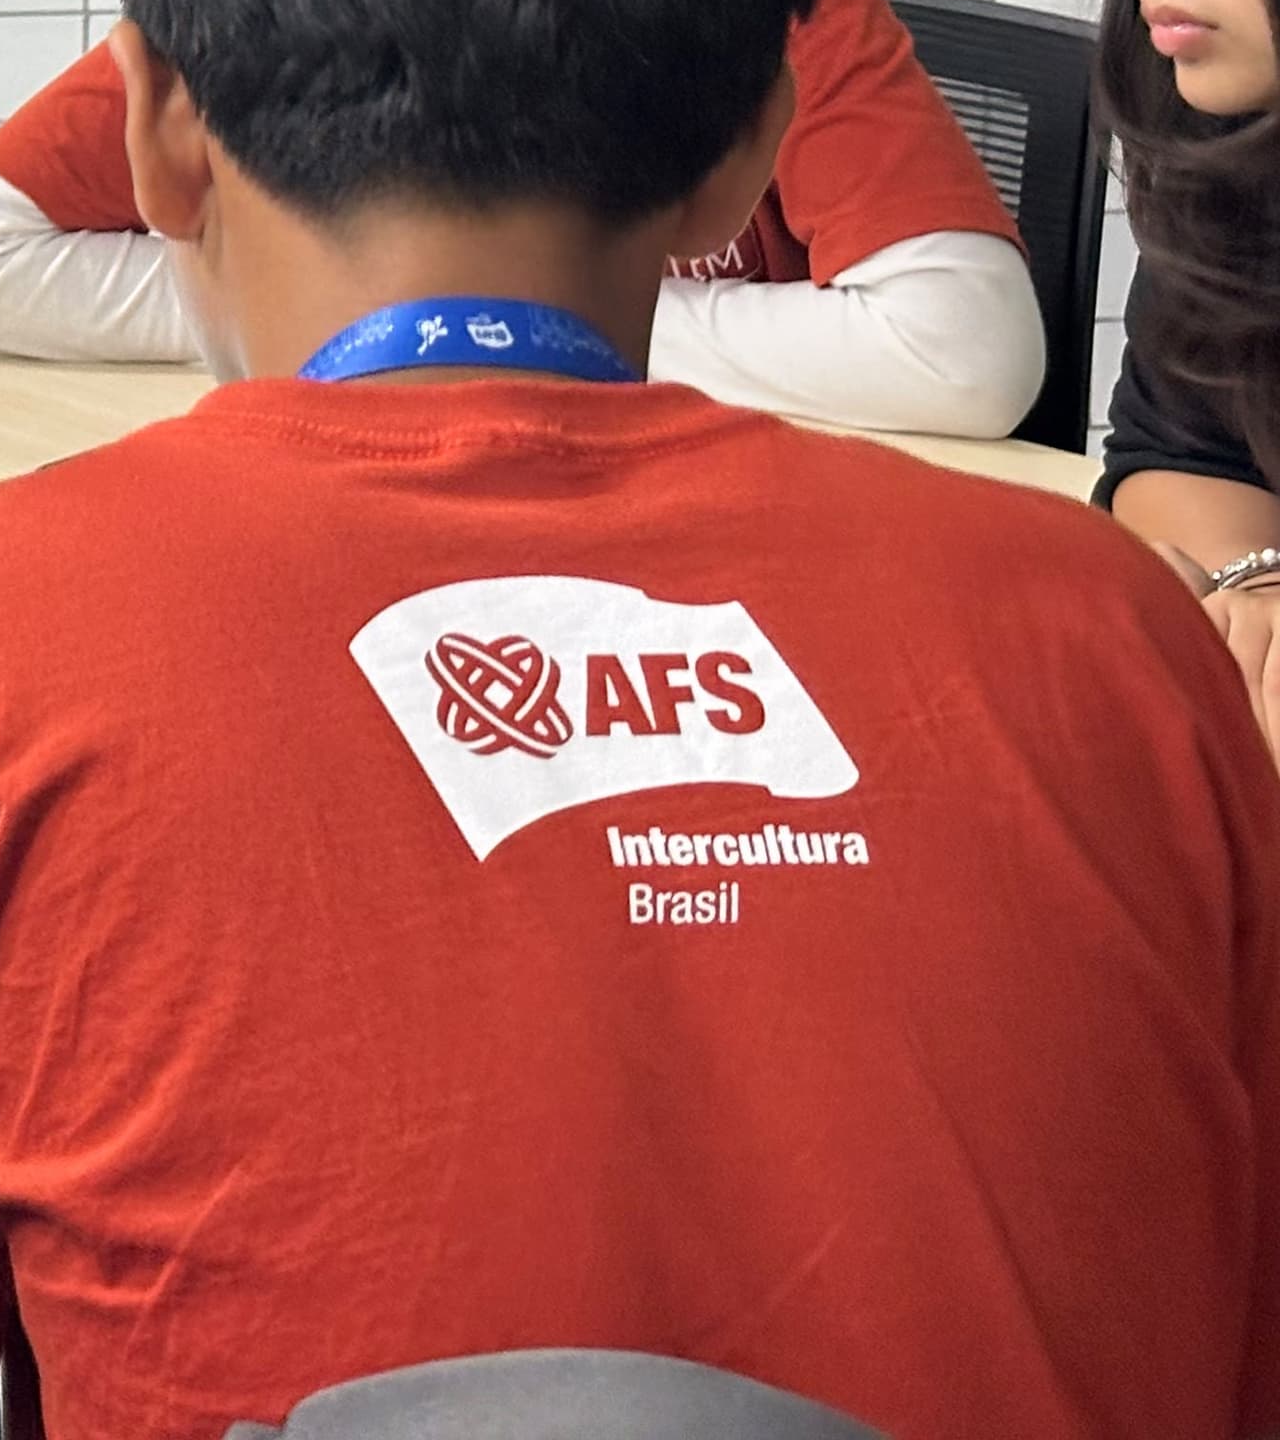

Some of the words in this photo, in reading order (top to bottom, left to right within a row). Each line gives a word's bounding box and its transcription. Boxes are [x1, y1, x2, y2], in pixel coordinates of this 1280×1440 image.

[585, 651, 766, 737] AFS
[607, 824, 869, 866] Intercultura
[628, 881, 740, 924] Brasil
